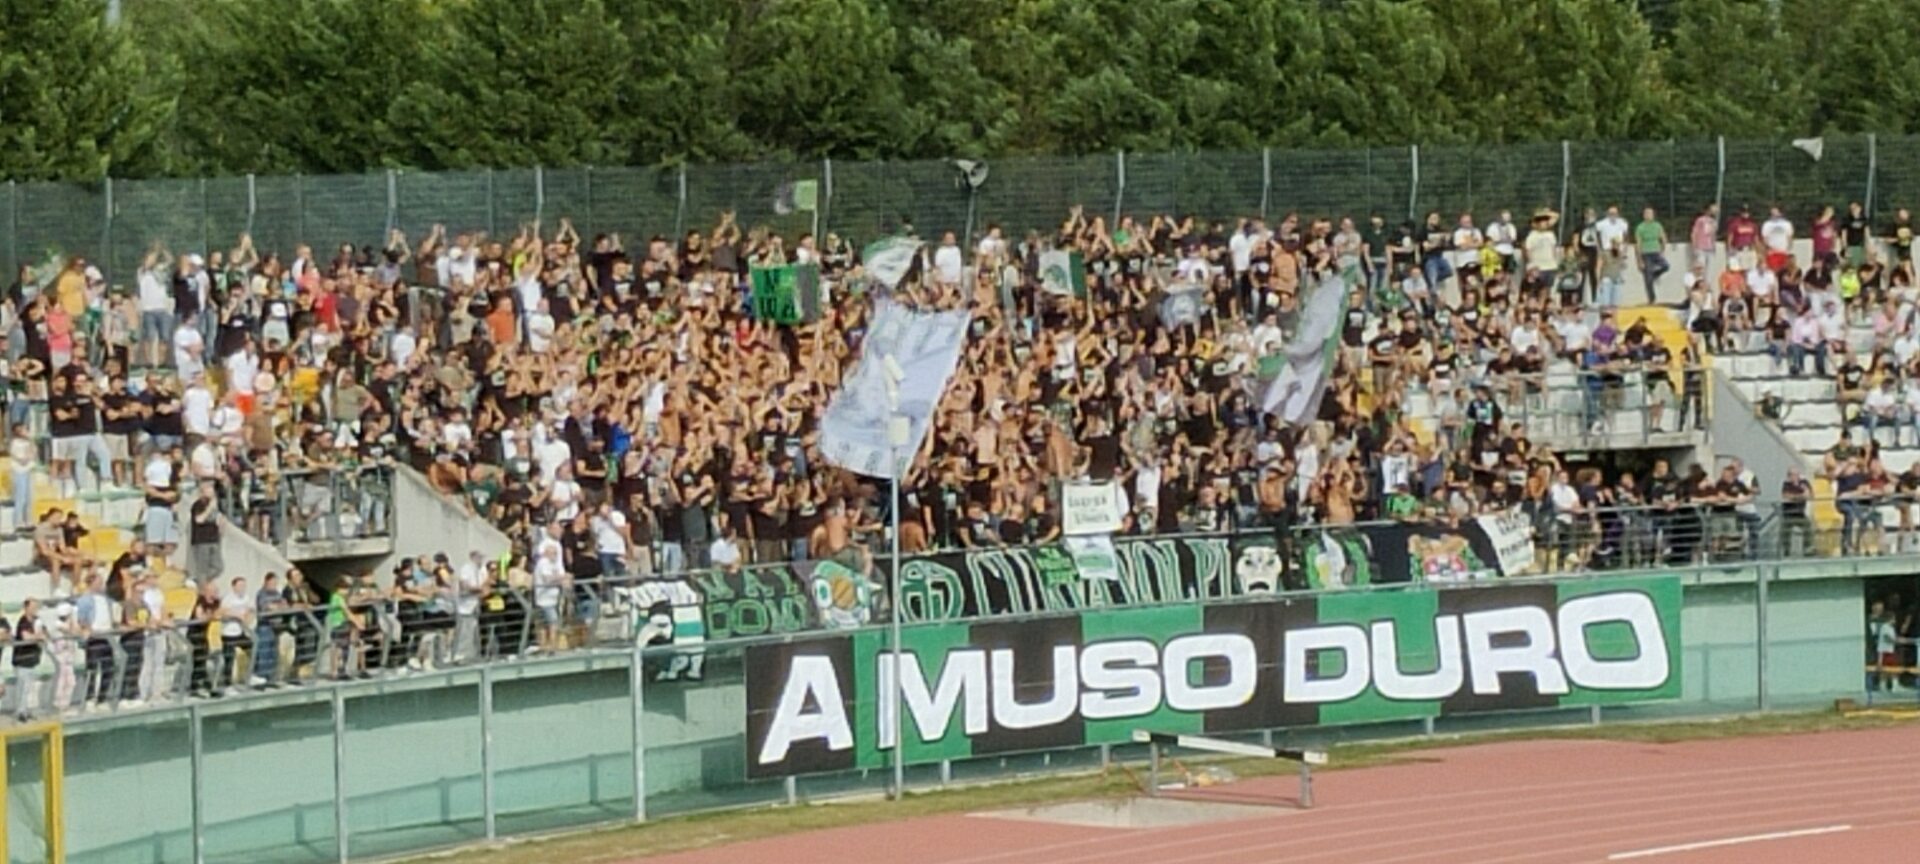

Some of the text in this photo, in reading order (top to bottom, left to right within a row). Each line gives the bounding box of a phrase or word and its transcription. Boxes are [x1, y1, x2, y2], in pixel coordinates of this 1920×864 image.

[758, 592, 1670, 764] A MUSO DURO
